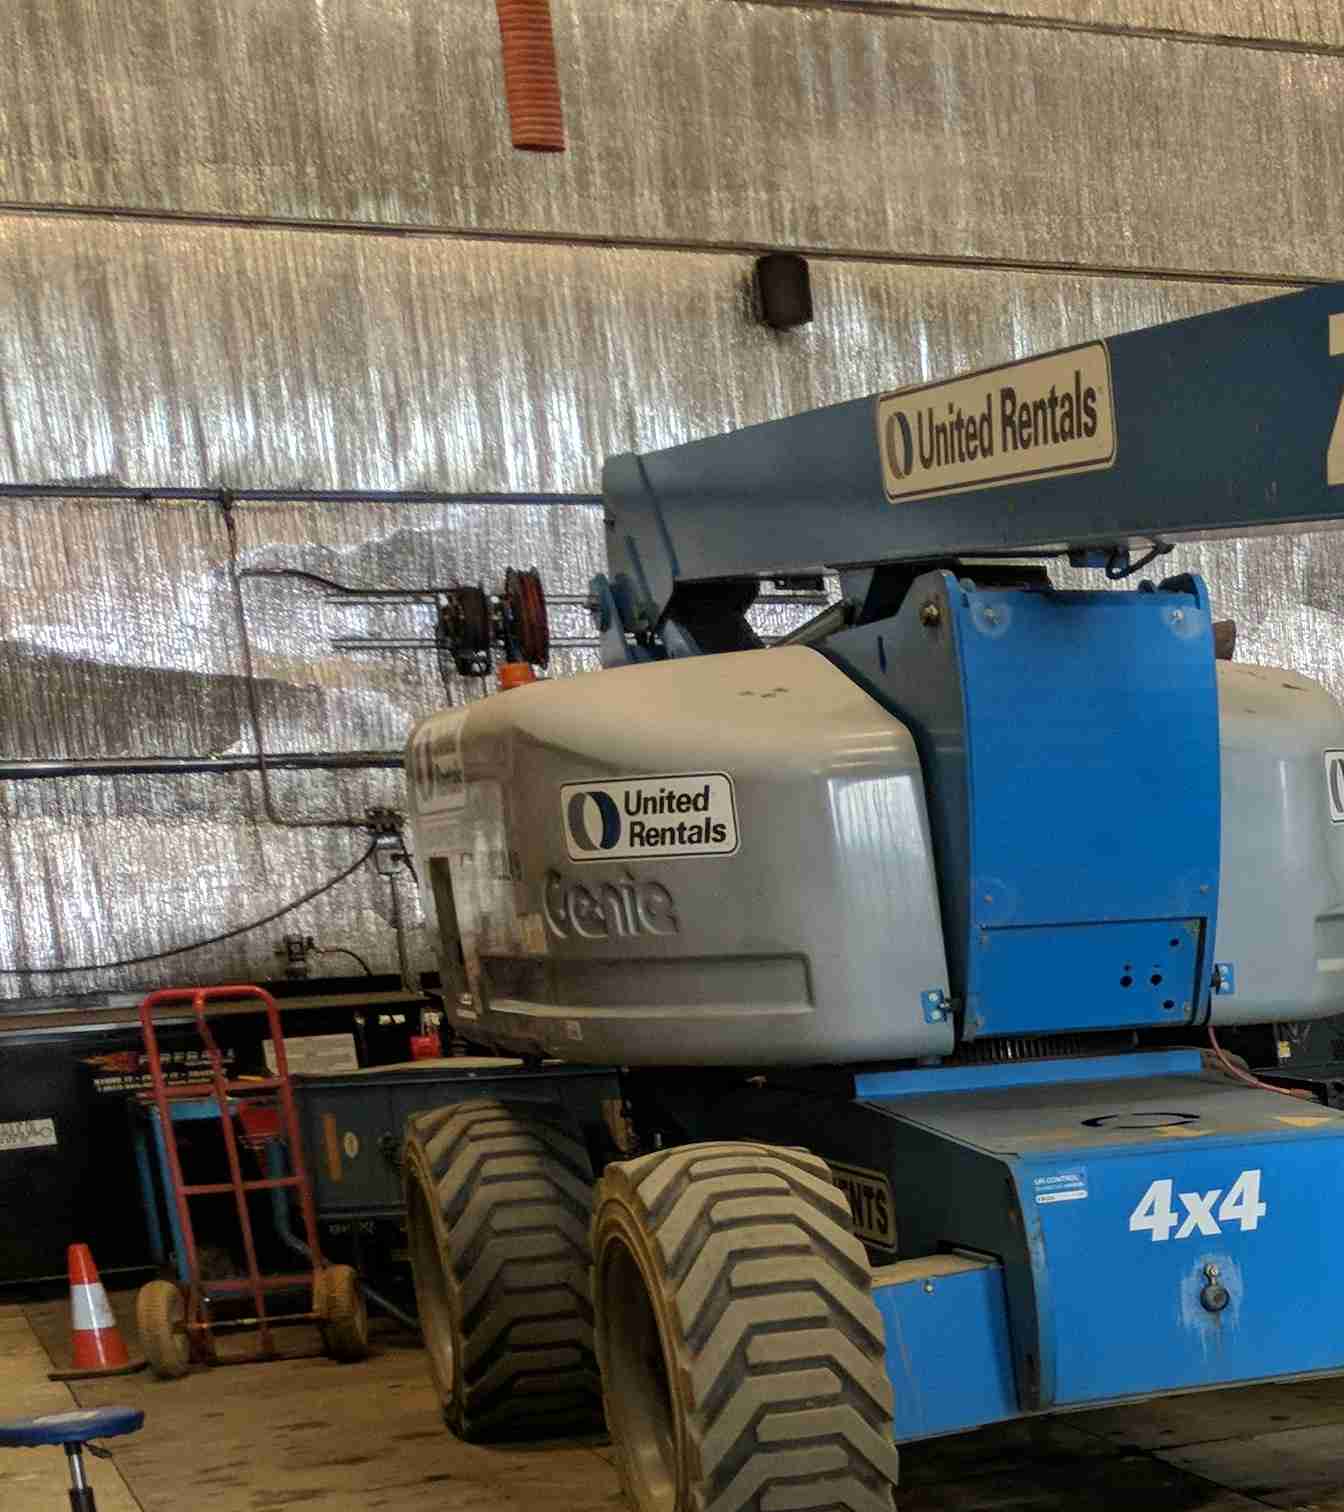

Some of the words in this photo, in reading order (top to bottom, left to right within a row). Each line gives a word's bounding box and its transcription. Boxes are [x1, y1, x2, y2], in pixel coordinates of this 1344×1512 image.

[916, 393, 994, 470] United
[1001, 370, 1097, 453] Rentals
[624, 784, 710, 817] United
[629, 817, 727, 848] Rentals
[1129, 1168, 1267, 1242] 4x4
